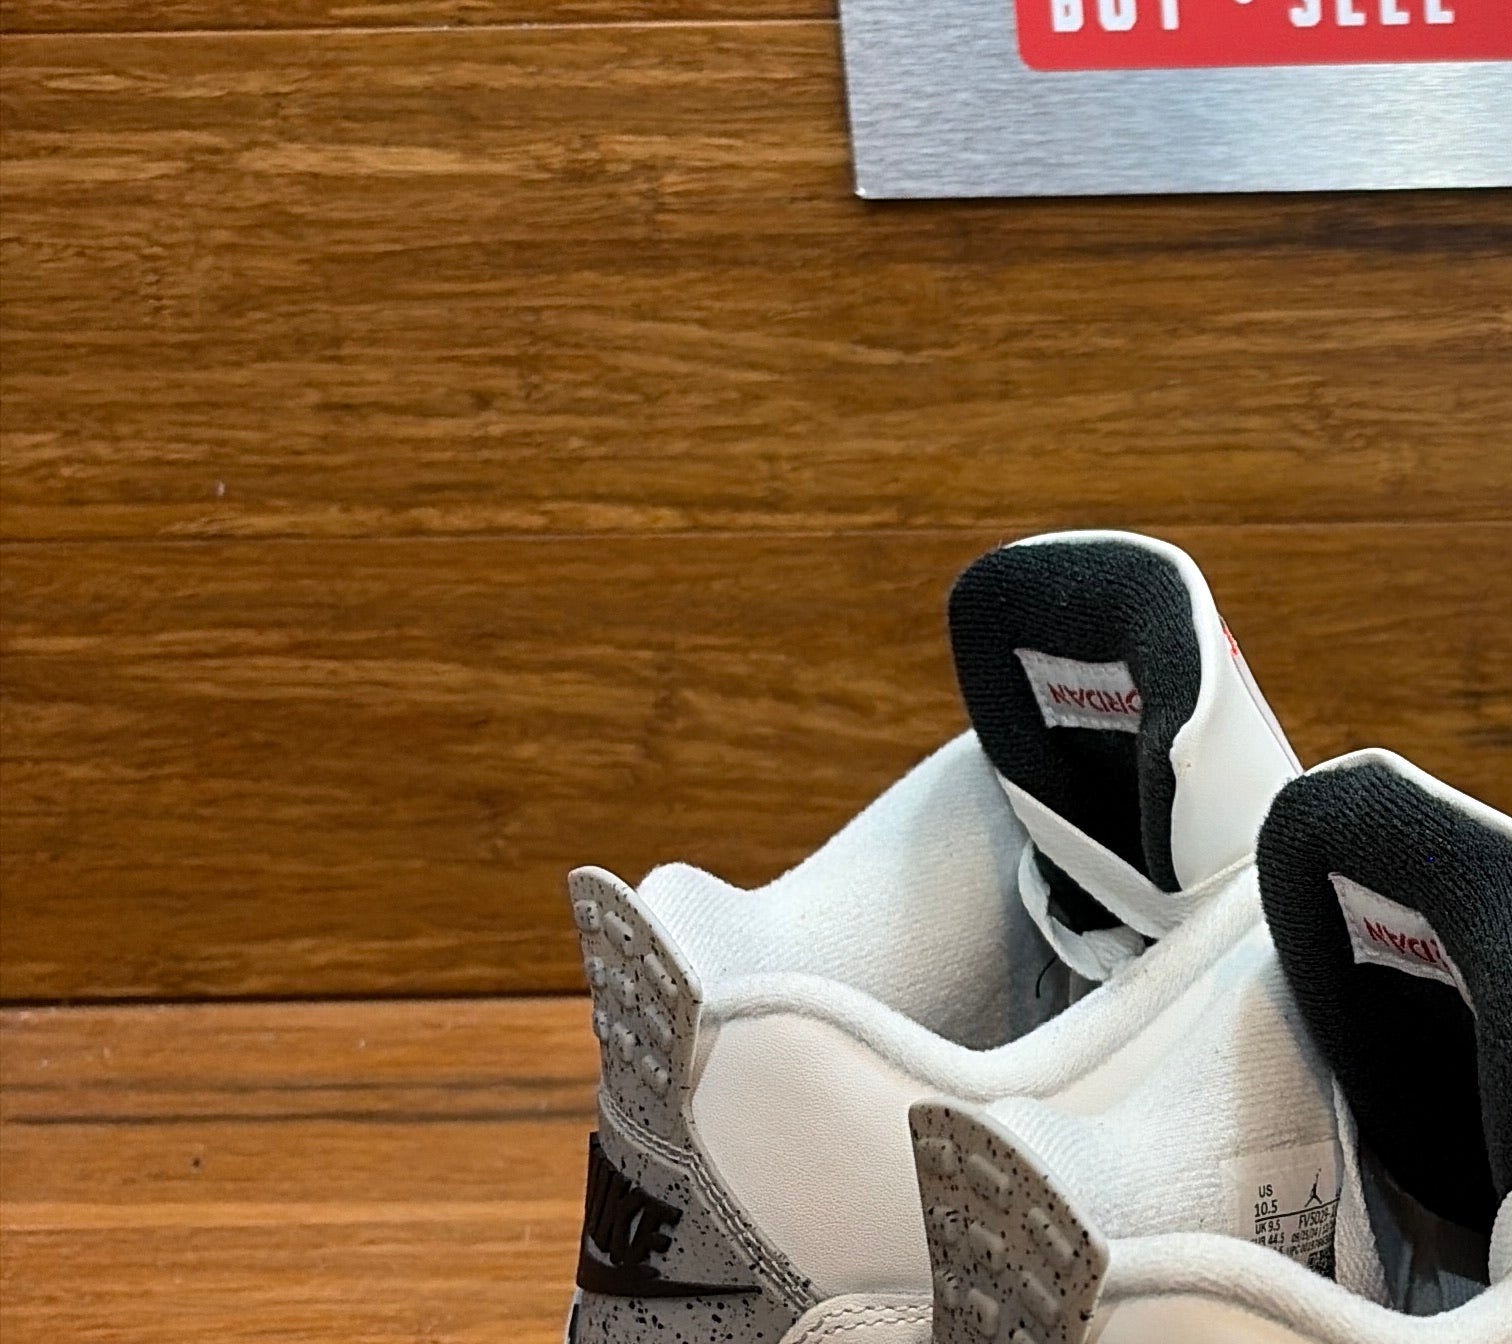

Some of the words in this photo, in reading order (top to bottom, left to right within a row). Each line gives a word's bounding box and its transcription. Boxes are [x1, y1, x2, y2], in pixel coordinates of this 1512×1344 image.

[1047, 681, 1142, 715] ORDAN
[1258, 1184, 1273, 1198] US
[1254, 1199, 1278, 1217] 10.5
